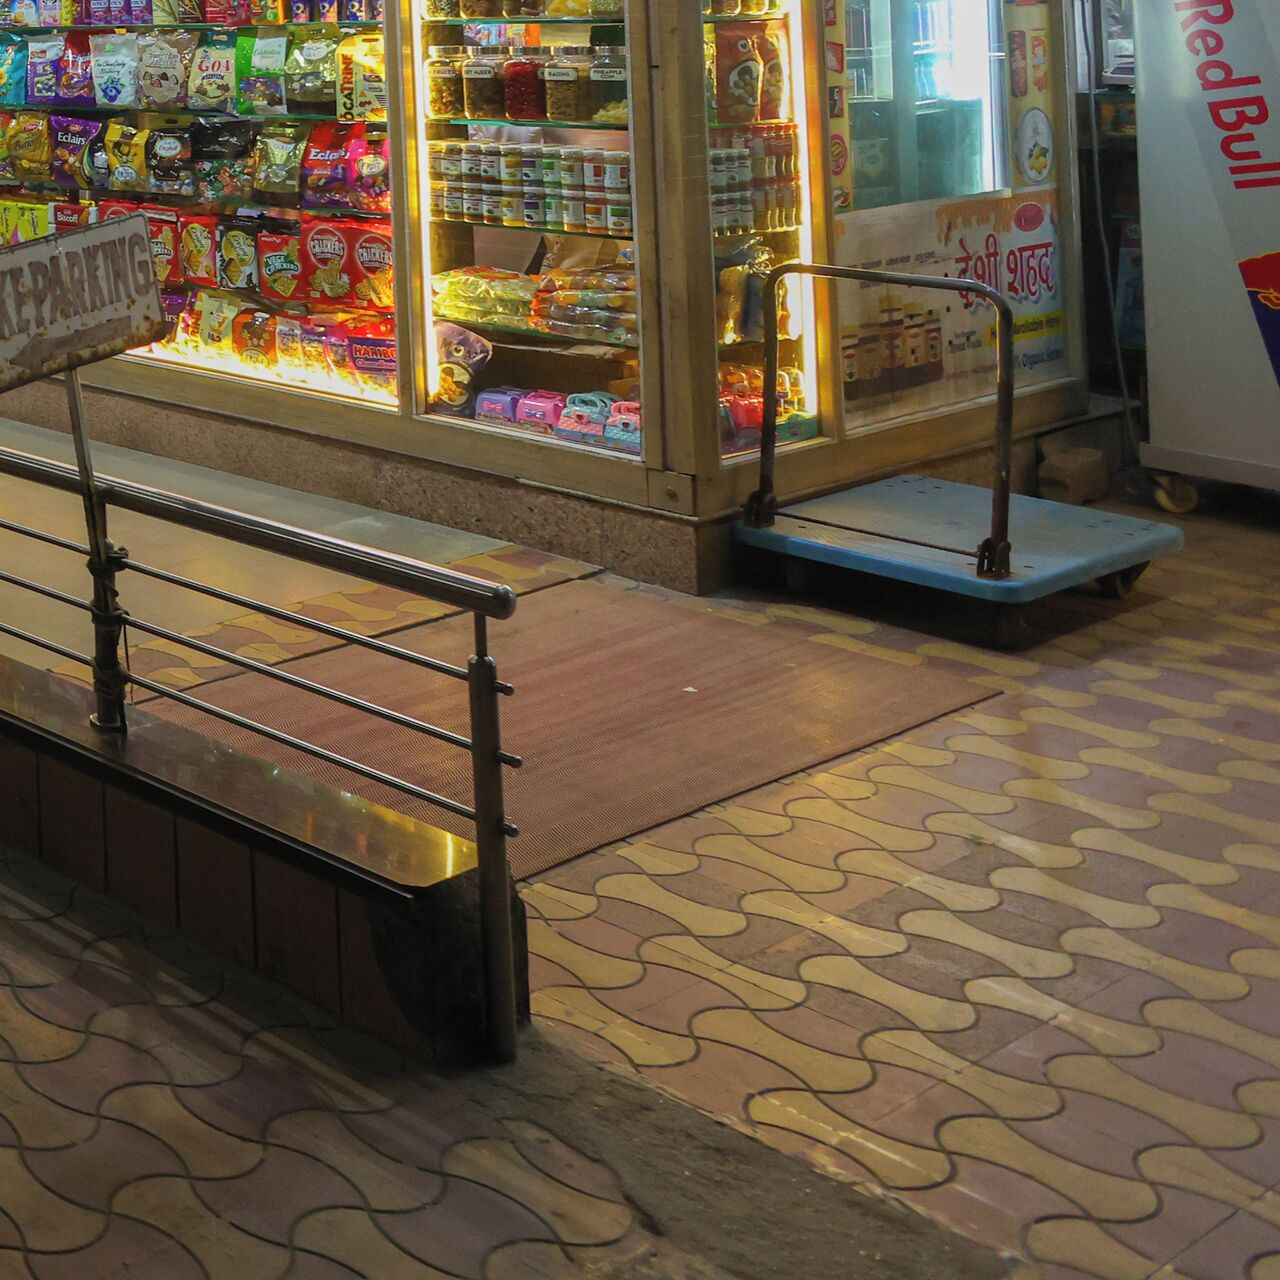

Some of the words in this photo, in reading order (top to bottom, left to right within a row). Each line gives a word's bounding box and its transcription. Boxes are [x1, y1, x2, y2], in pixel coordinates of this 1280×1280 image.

[57, 132, 87, 146] Eclairs
[1207, 95, 1280, 190] Bull
[56, 212, 79, 224] Biscoff
[310, 240, 346, 255] CRACKERS
[1007, 241, 1056, 297] शहद
